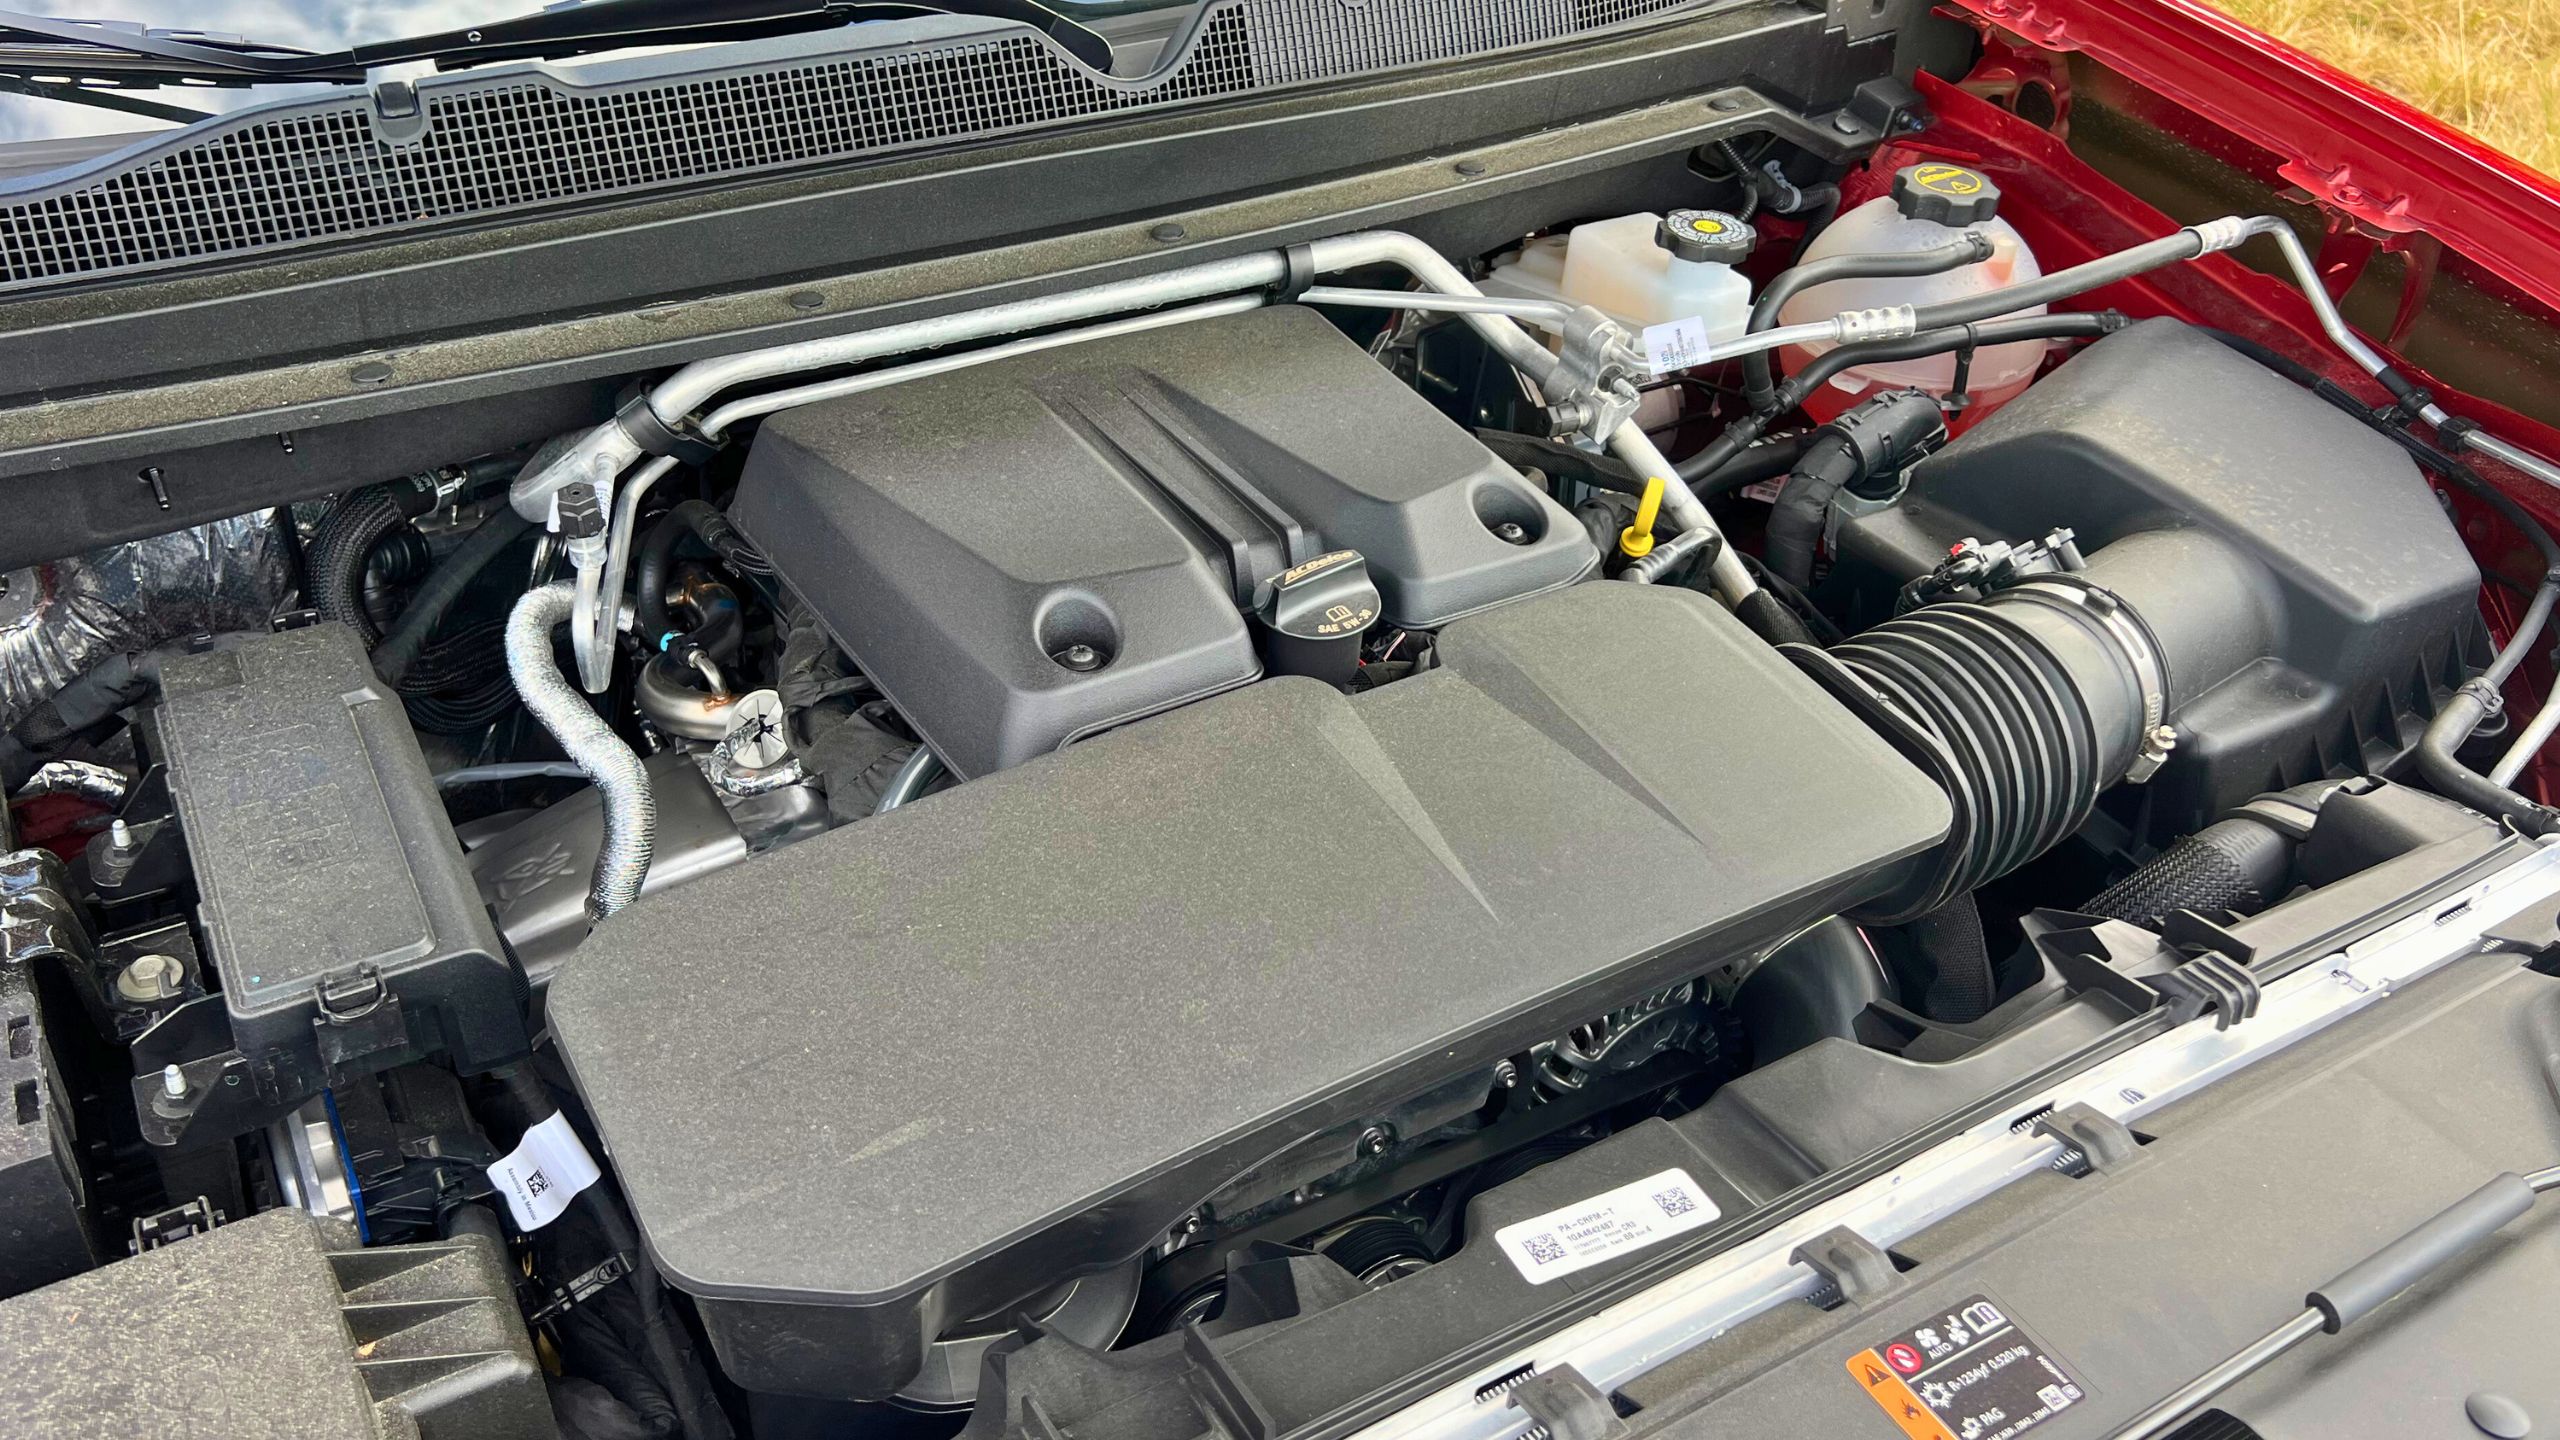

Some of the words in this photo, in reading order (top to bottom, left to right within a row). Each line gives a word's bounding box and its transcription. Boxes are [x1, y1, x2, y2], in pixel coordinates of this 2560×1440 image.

[1285, 551, 1353, 585] ACDelco
[1318, 624, 1341, 633] SAE
[1343, 609, 1372, 629] 5W-30
[1928, 1342, 1953, 1360] AUTO
[1947, 1362, 1990, 1392] R-1234yf
[1987, 1350, 2016, 1370] 0.520
[2010, 1345, 2031, 1358] kg
[1979, 1407, 2006, 1426] PAG
